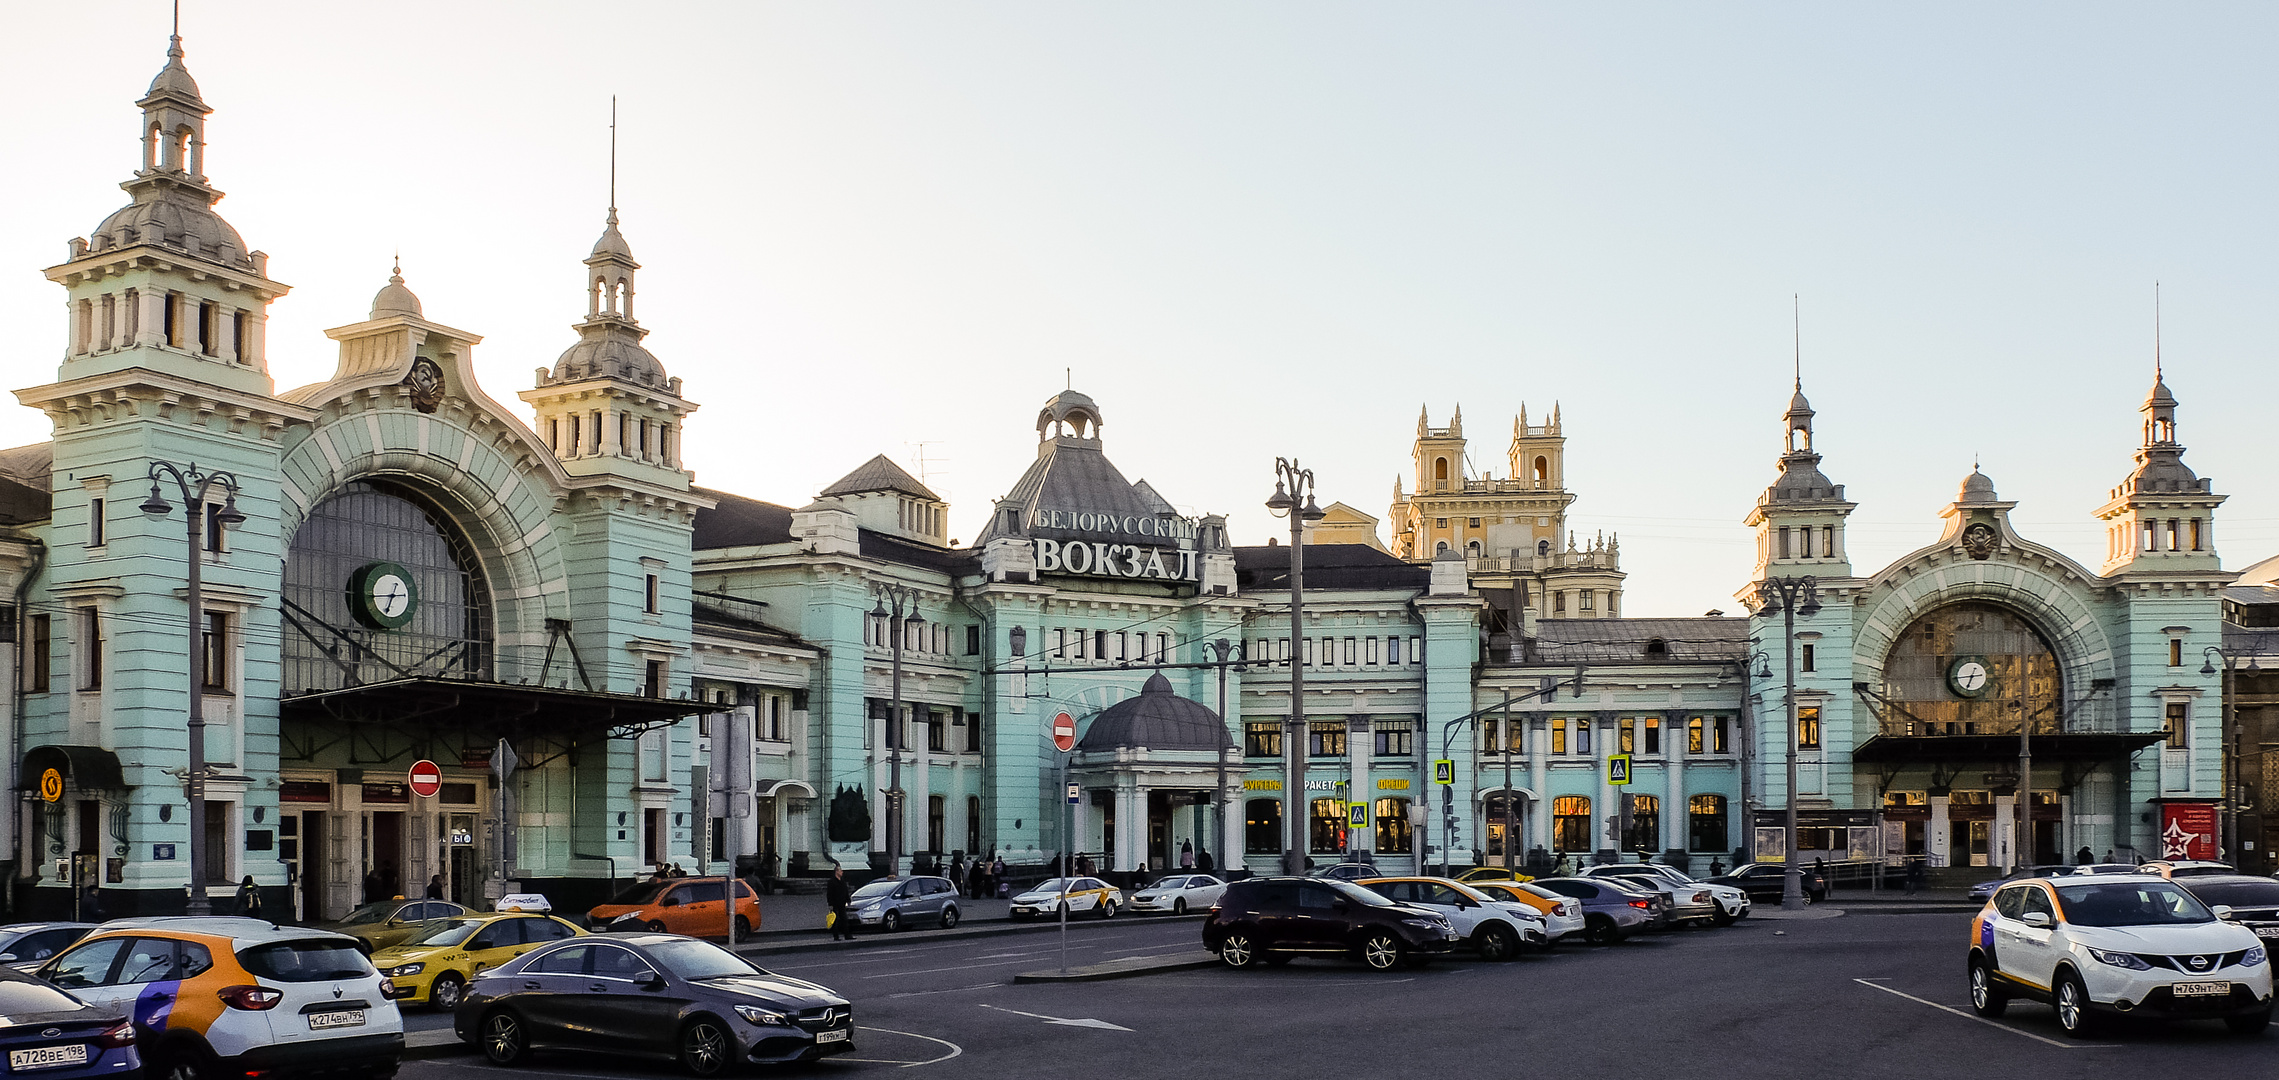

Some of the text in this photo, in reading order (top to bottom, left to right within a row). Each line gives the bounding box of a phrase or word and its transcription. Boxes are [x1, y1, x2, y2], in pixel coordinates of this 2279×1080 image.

[1034, 508, 1198, 540] БЕЛОРУССКИЙ
[1034, 538, 1199, 582] ВОКЗАЛ
[1376, 779, 1410, 790] ФРЕШИ
[15, 1049, 64, 1065] А728ВЕ
